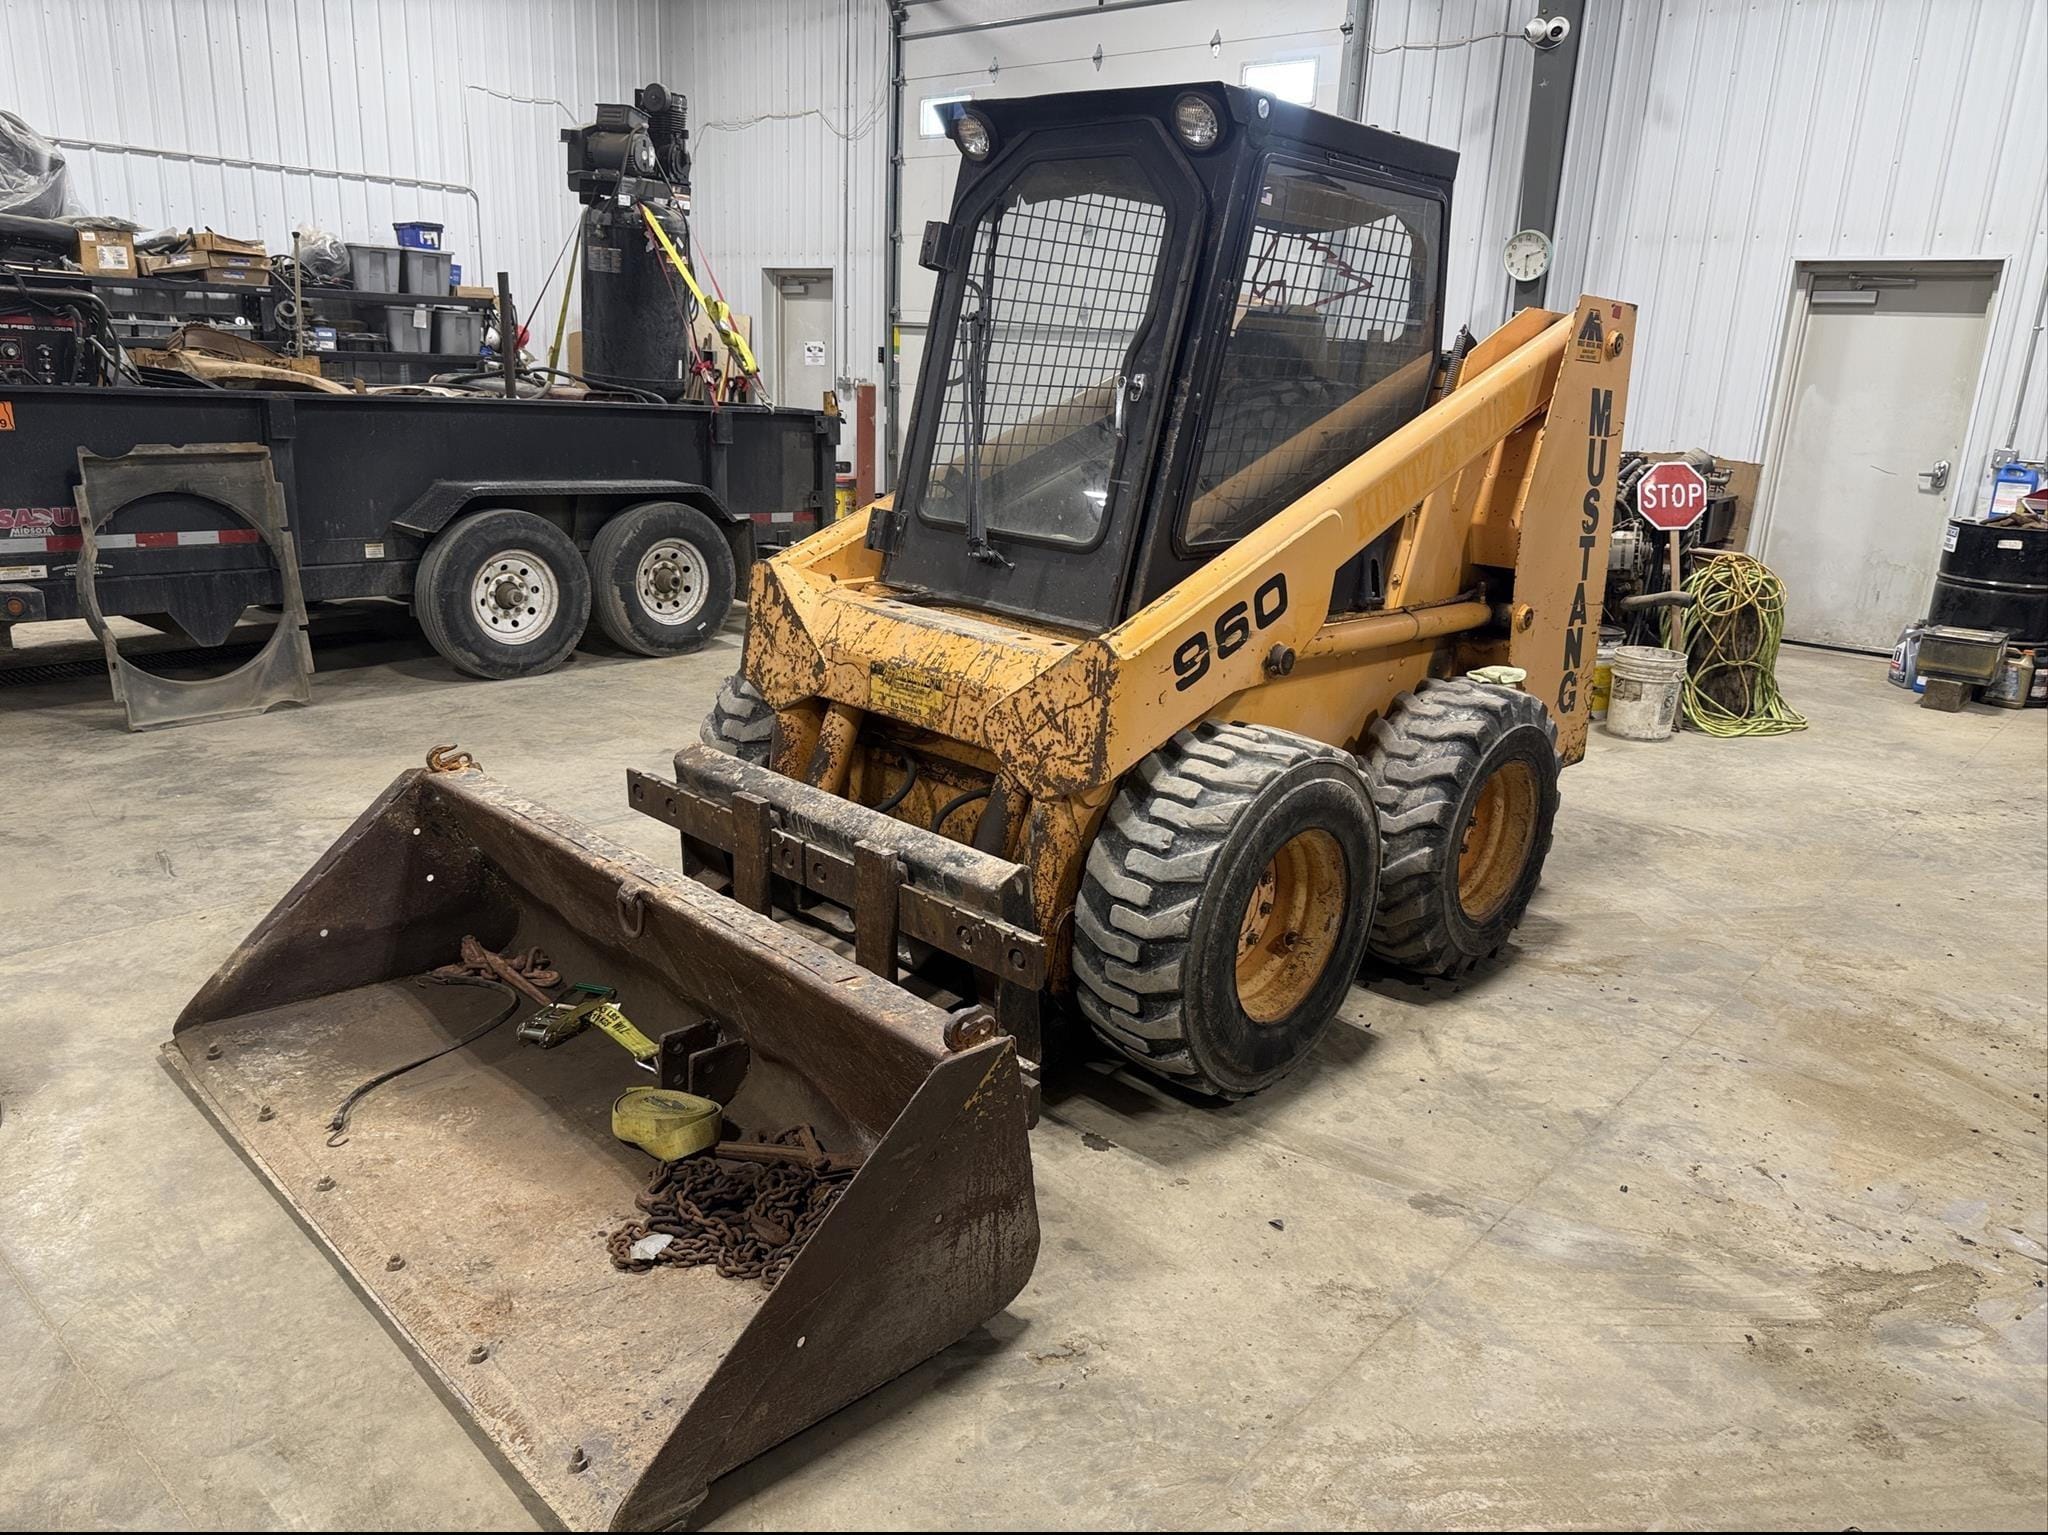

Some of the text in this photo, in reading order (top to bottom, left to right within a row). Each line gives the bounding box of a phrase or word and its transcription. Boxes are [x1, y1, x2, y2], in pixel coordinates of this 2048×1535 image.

[9, 527, 55, 537] MIDSOTA
[1643, 483, 1702, 509] STOP
[1558, 387, 1613, 714] MUSTANG
[1173, 572, 1288, 691] 960
